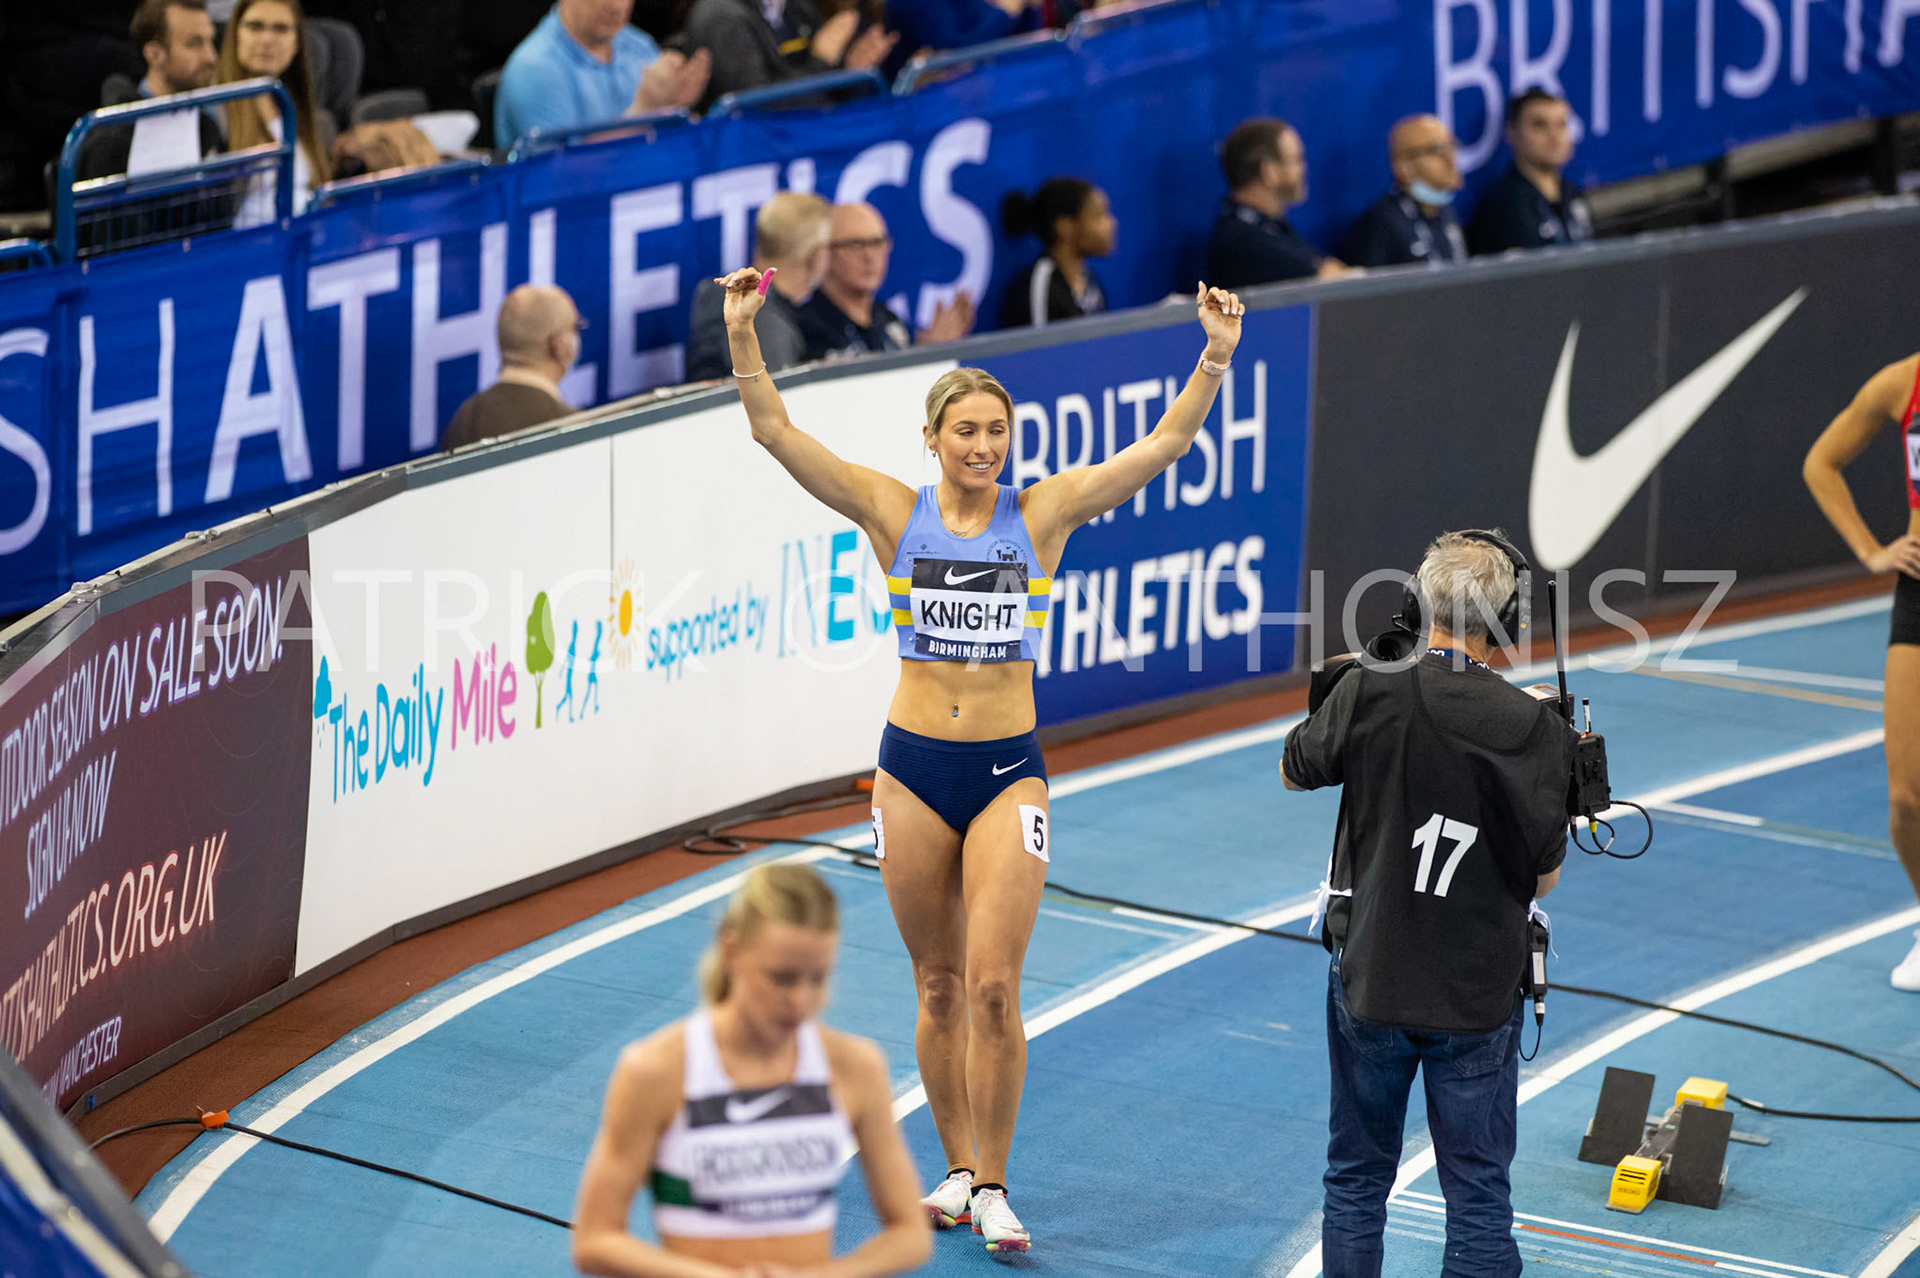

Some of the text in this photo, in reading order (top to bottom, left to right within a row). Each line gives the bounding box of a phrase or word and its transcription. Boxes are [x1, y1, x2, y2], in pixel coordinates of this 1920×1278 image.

[921, 600, 1017, 631] KNIGHT
[928, 640, 1007, 659] BIRMINGHAM
[49, 653, 99, 781] SEASON
[100, 633, 141, 734] ON
[140, 609, 207, 716] SALE
[208, 577, 283, 689] SOON.
[329, 691, 369, 805] The
[375, 662, 443, 788] Daily
[451, 641, 517, 752] Mile
[646, 587, 741, 682] supported
[746, 581, 770, 653] by
[24, 803, 56, 920] SIGN
[69, 749, 116, 864] NOW
[1033, 815, 1044, 852] 5
[1411, 813, 1480, 898] 17
